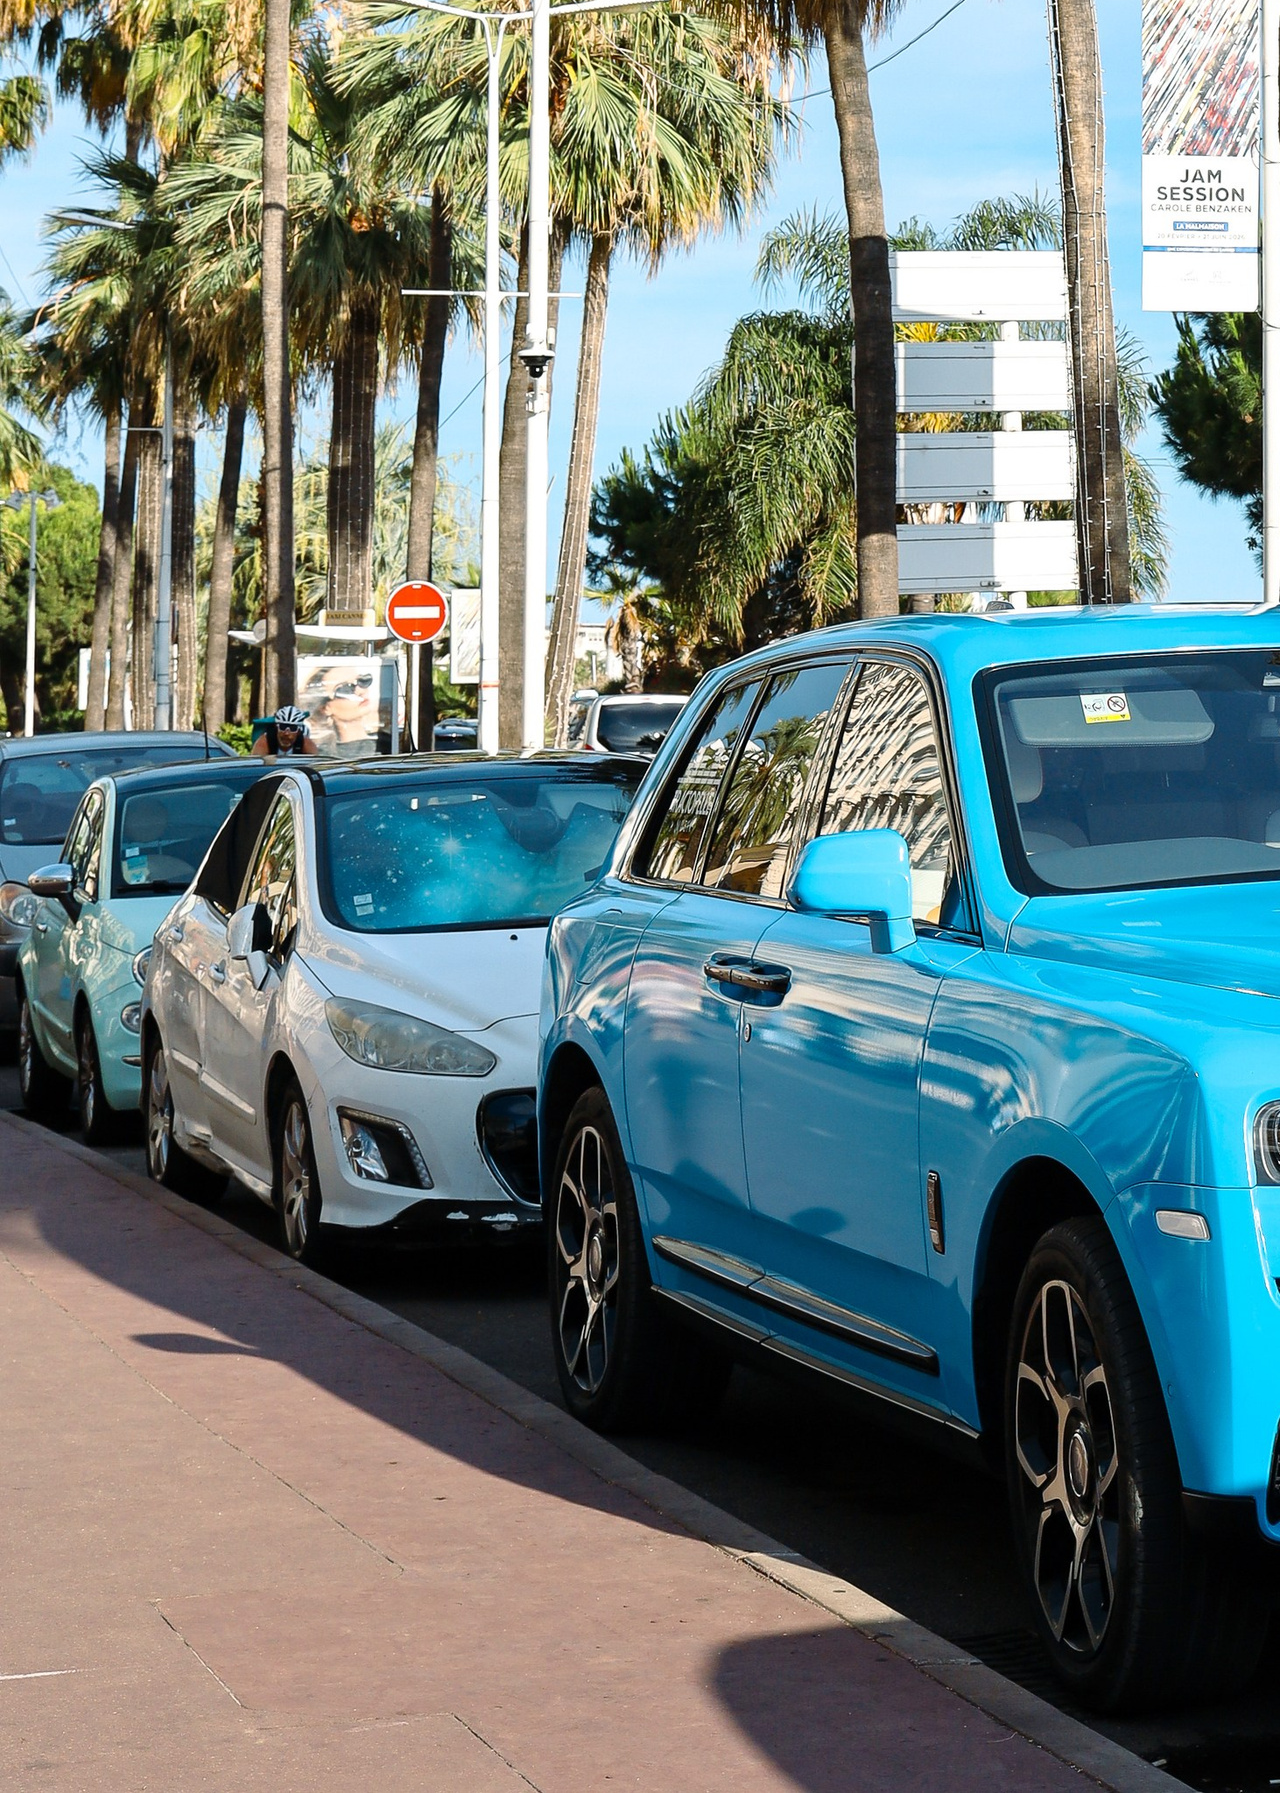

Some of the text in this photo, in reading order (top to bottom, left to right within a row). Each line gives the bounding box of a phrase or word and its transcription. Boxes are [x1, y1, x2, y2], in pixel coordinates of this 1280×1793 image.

[1180, 169, 1221, 183] JAM
[1157, 186, 1244, 202] SESSION
[1151, 204, 1252, 213] CAROLE BENZAKEN
